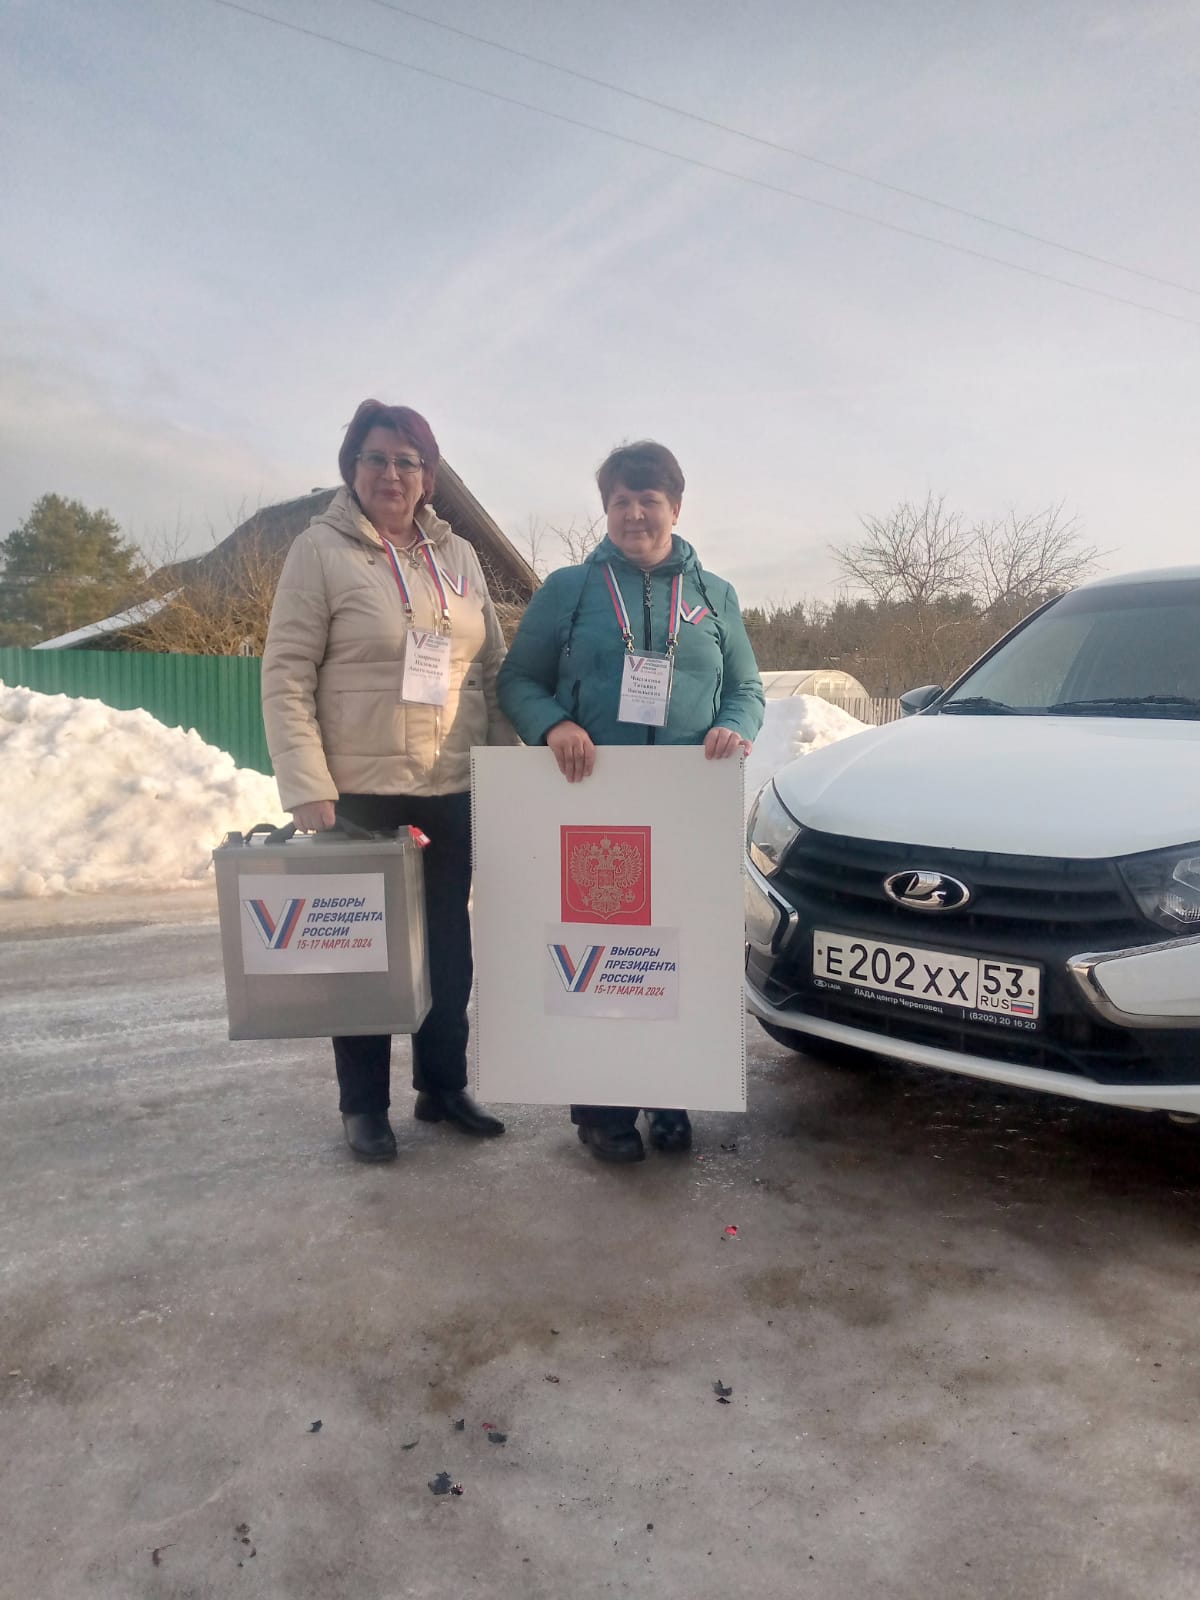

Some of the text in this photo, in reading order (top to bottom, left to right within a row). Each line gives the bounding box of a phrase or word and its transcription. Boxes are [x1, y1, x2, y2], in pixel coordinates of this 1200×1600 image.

[311, 897, 366, 908] ВЫБОРЫ
[306, 911, 384, 924] ПРЕЗИДЕНТА
[301, 926, 350, 937] РОССИИ
[296, 937, 373, 950] 15-17 МАРТА 2024
[610, 946, 660, 957] ВЫБОРЫ
[604, 960, 676, 972] ПРЕЗИДЕНТА
[599, 973, 645, 984] РОССИИ
[983, 964, 1024, 998] 53
[593, 985, 666, 997] 15-17 МАРТА 2024
[980, 995, 1010, 1010] RUS
[853, 988, 876, 999] ЛАДА
[899, 998, 944, 1014] Череповец
[969, 1012, 997, 1024] (8202)
[999, 1017, 1011, 1025] 20
[1024, 1021, 1037, 1030] 20
